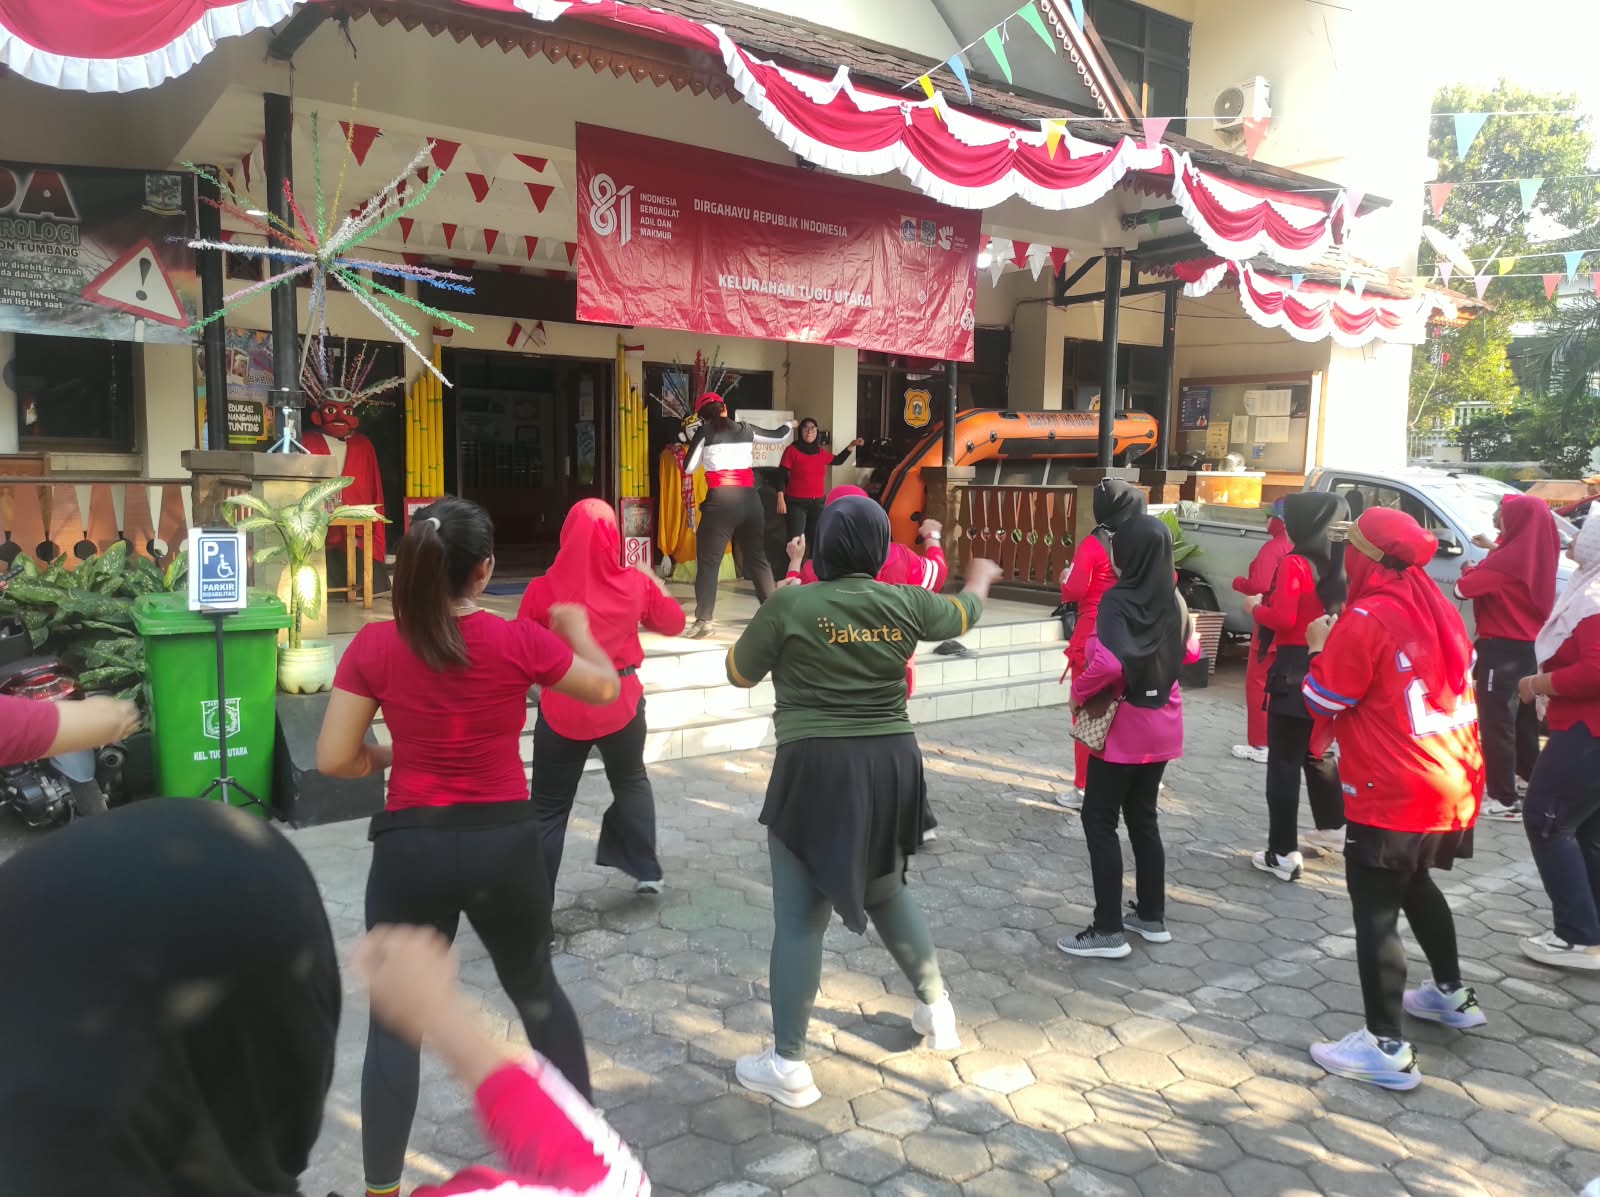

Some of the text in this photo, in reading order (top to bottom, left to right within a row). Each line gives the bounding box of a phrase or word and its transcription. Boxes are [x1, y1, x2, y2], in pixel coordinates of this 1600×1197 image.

[640, 193, 677, 206] INDONESIA
[588, 173, 635, 247] 81
[640, 204, 680, 218] BERDAULAT
[640, 216, 672, 228] ADIL DAN
[694, 198, 848, 238] DIRGAHAYU REPUBLIK INDONESIA
[640, 227, 672, 240] MAKMUR
[20, 242, 79, 257] TUMBANG
[14, 271, 42, 279] dalam
[3, 287, 27, 298] tiang
[718, 273, 873, 308] KELURAHAN TUGU UTARA
[15, 297, 42, 307] listrik
[44, 301, 63, 309] saat
[228, 403, 254, 413] EDUKASI
[203, 542, 219, 565] P
[203, 583, 235, 592] PARKIR
[193, 751, 208, 761] KEL.
[227, 746, 249, 758] UTARA
